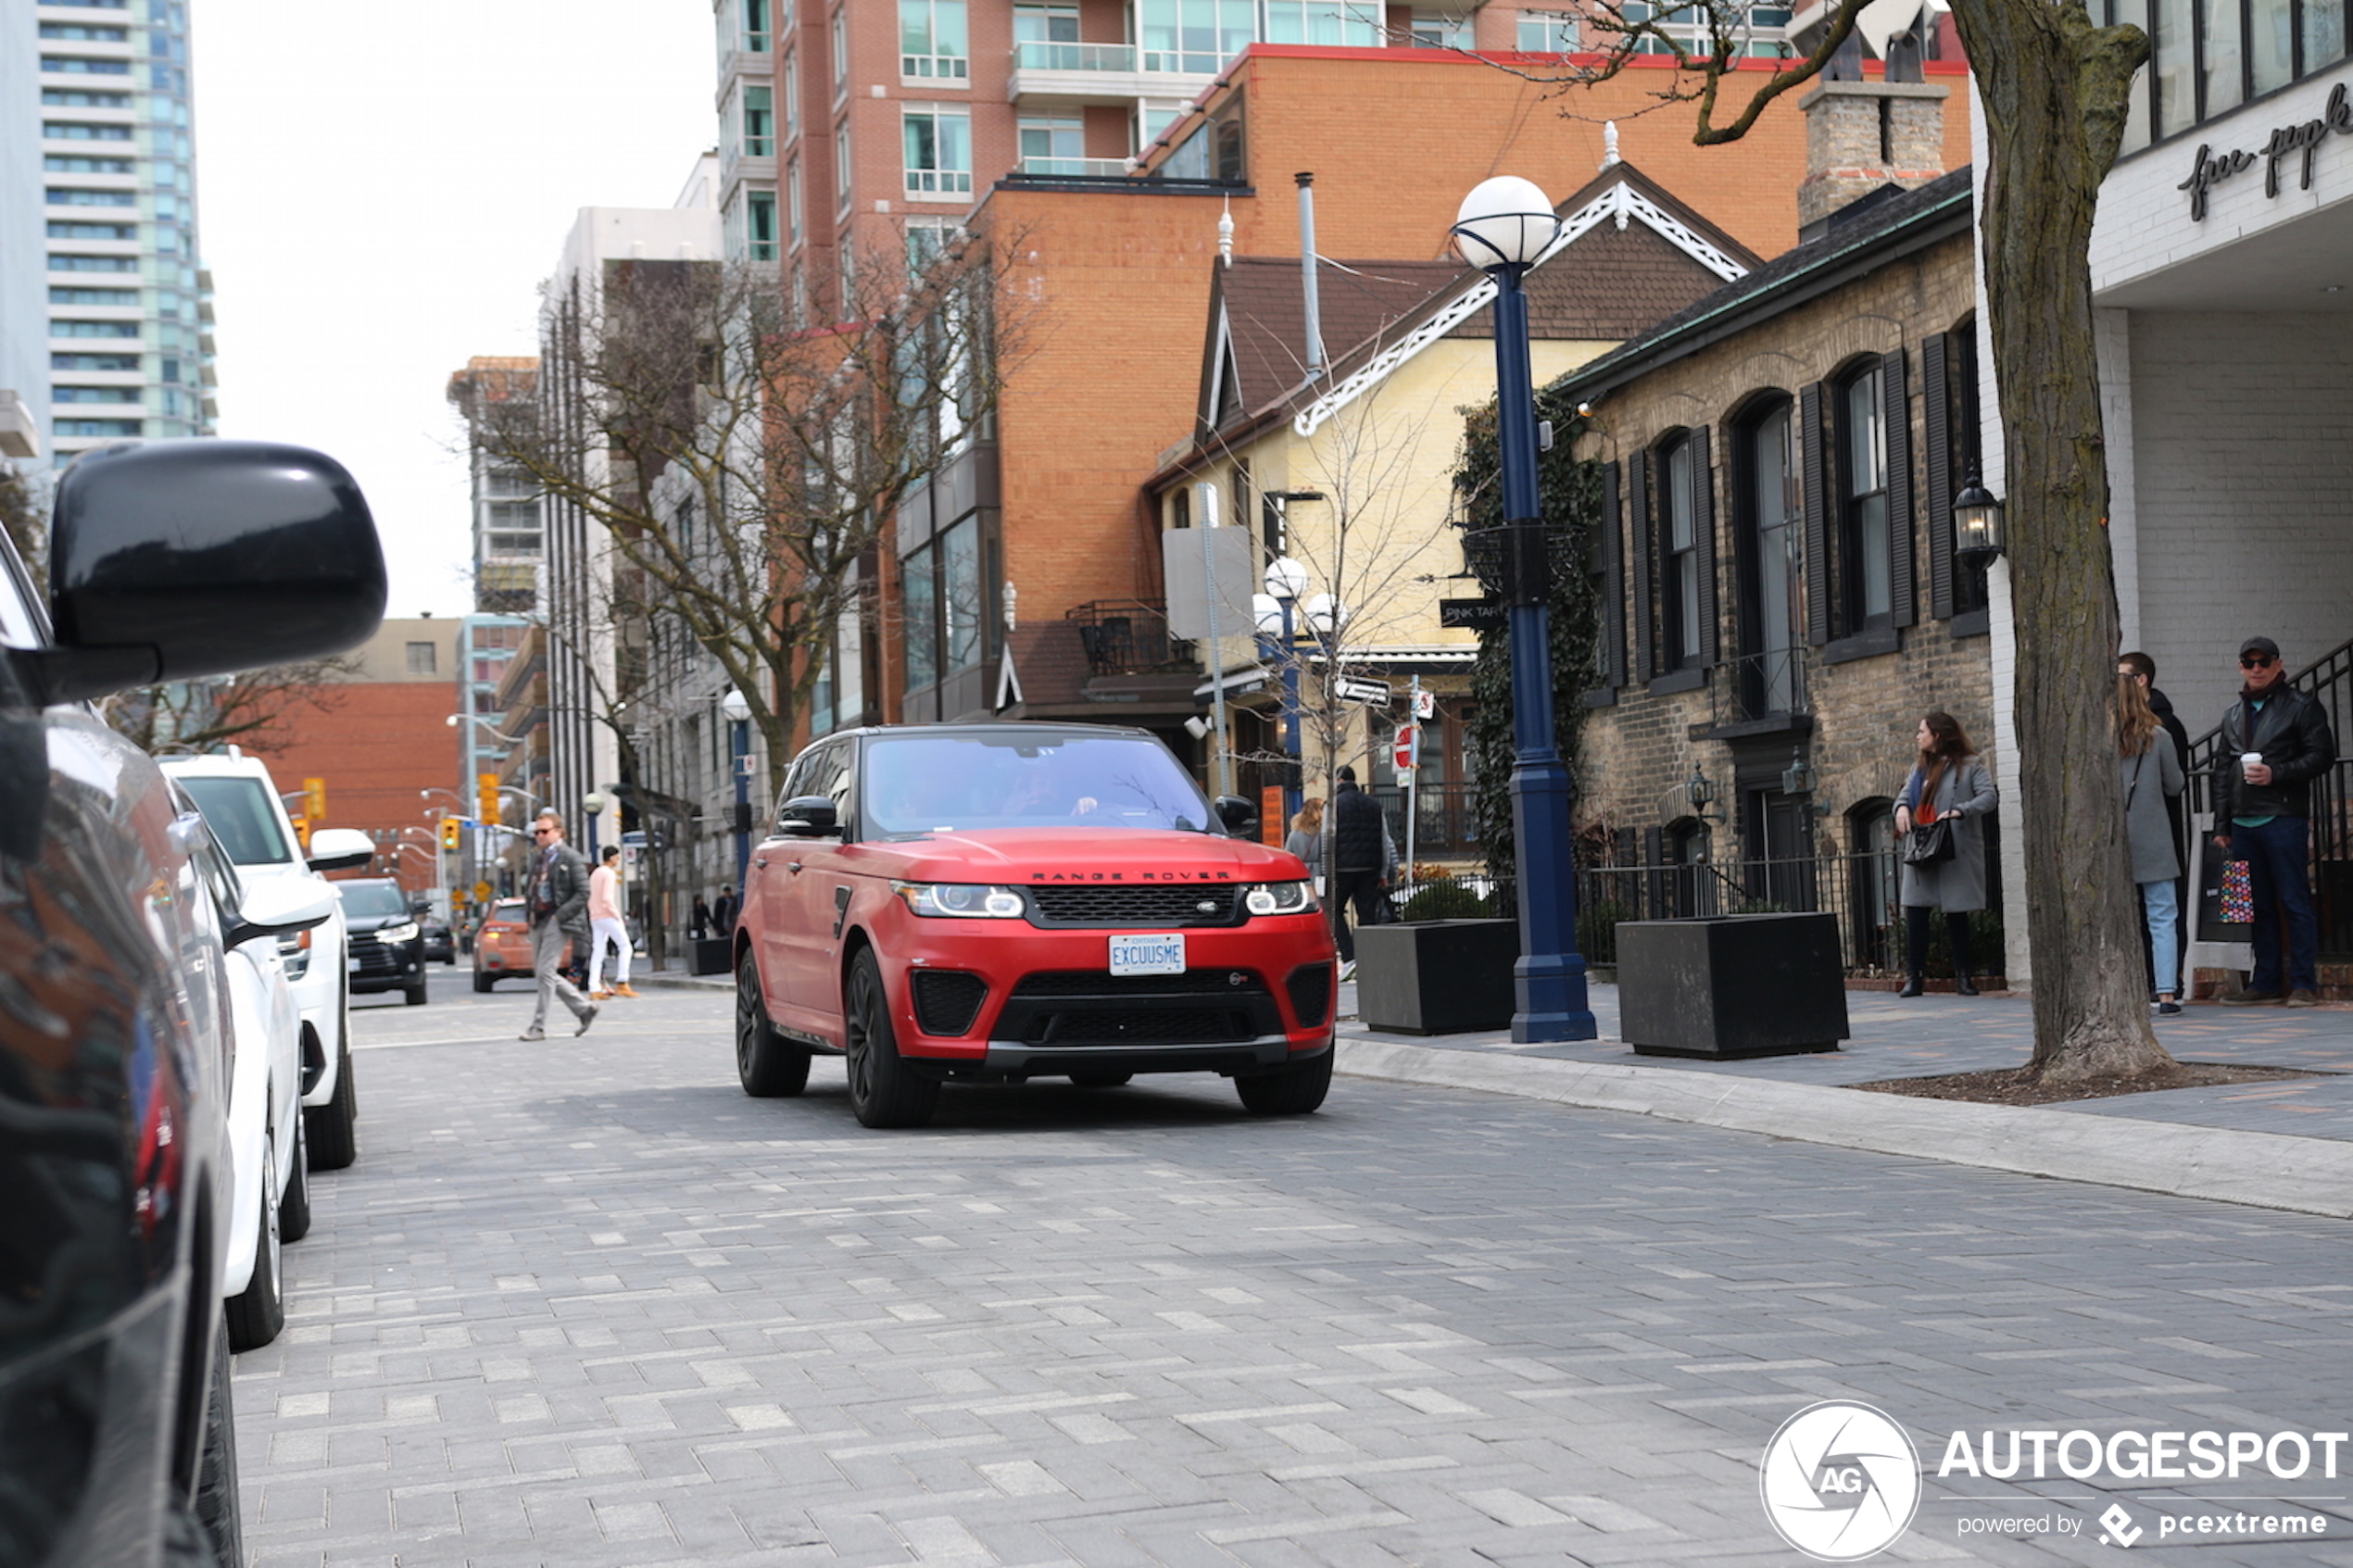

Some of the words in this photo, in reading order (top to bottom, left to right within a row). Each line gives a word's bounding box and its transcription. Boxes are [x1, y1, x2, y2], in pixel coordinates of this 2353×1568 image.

[2177, 144, 2258, 222] free
[2259, 82, 2353, 199] people
[1445, 607, 1474, 619] PINK
[1476, 606, 1499, 618] TAR
[1032, 872, 1123, 881] RANGE
[1142, 872, 1230, 880] ROVER
[1113, 944, 1181, 965] EXCUUSME
